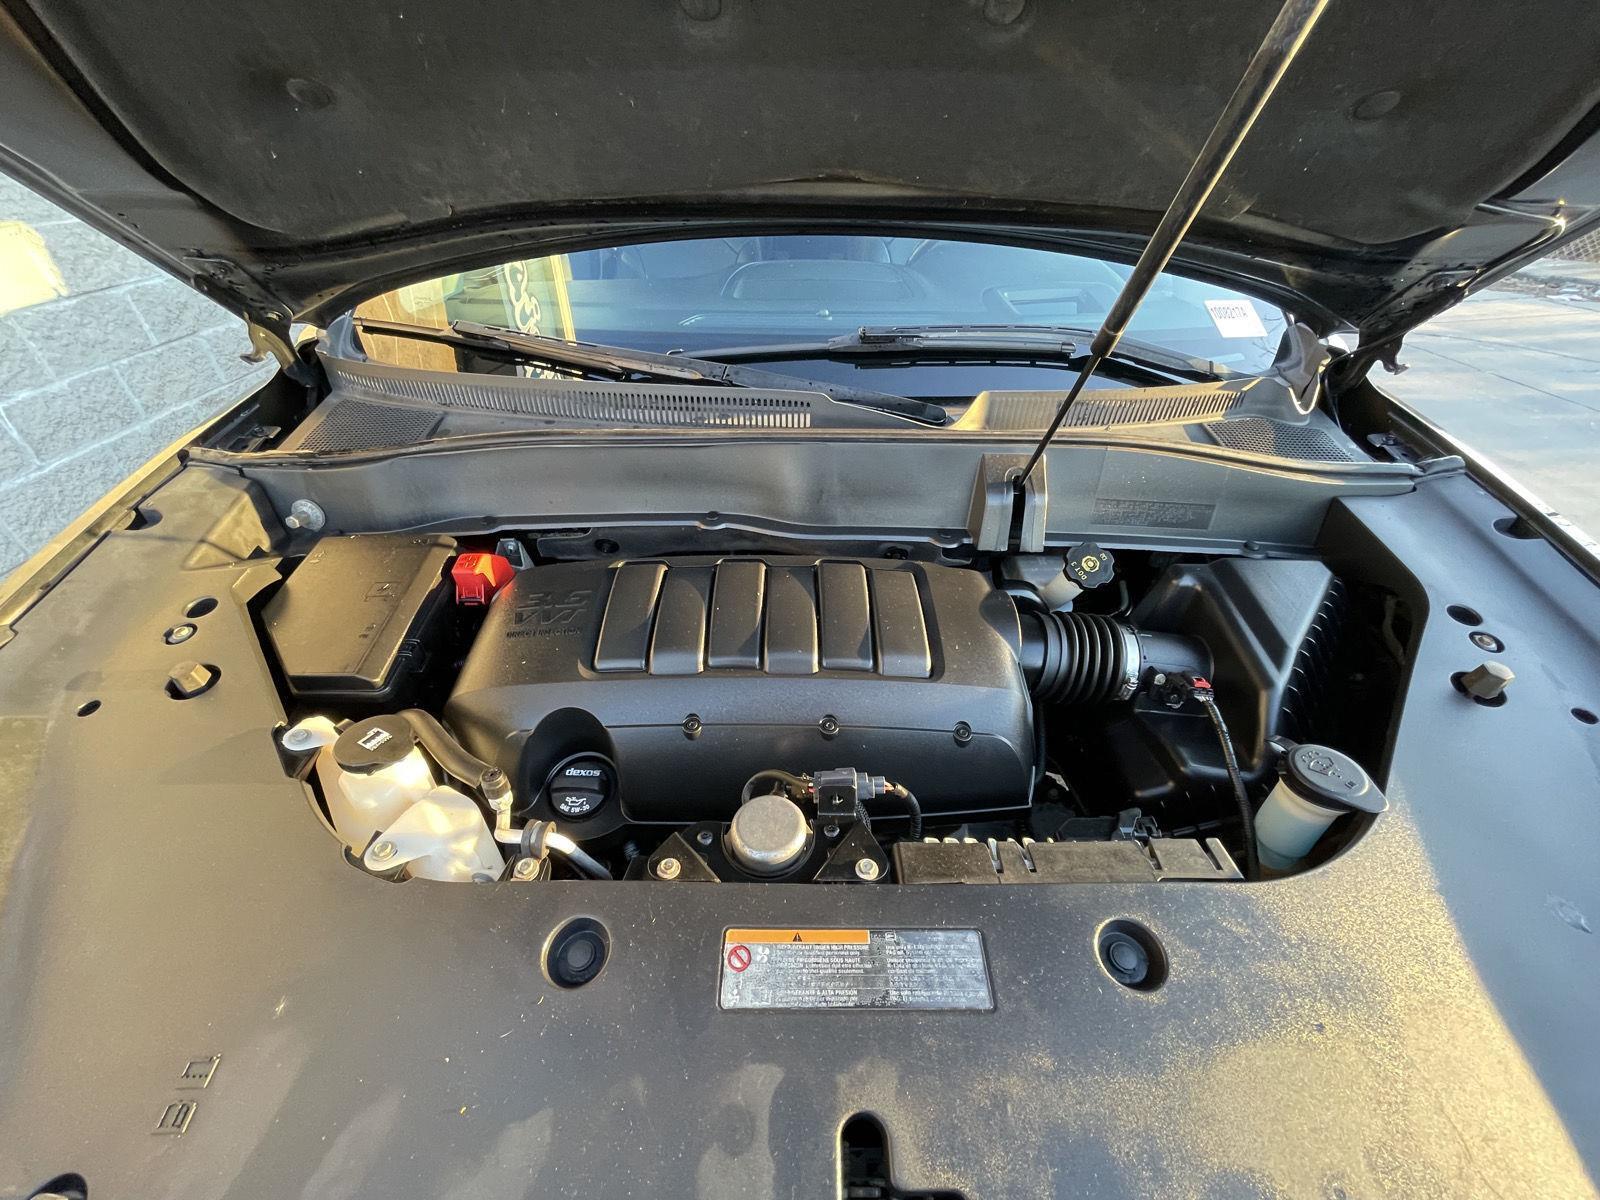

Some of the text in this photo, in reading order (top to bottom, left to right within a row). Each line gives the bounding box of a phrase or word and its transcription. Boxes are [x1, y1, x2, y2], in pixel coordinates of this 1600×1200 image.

[1074, 567, 1088, 581] DOT
[565, 767, 602, 777] dexos
[559, 803, 590, 813] SAE 5W-30
